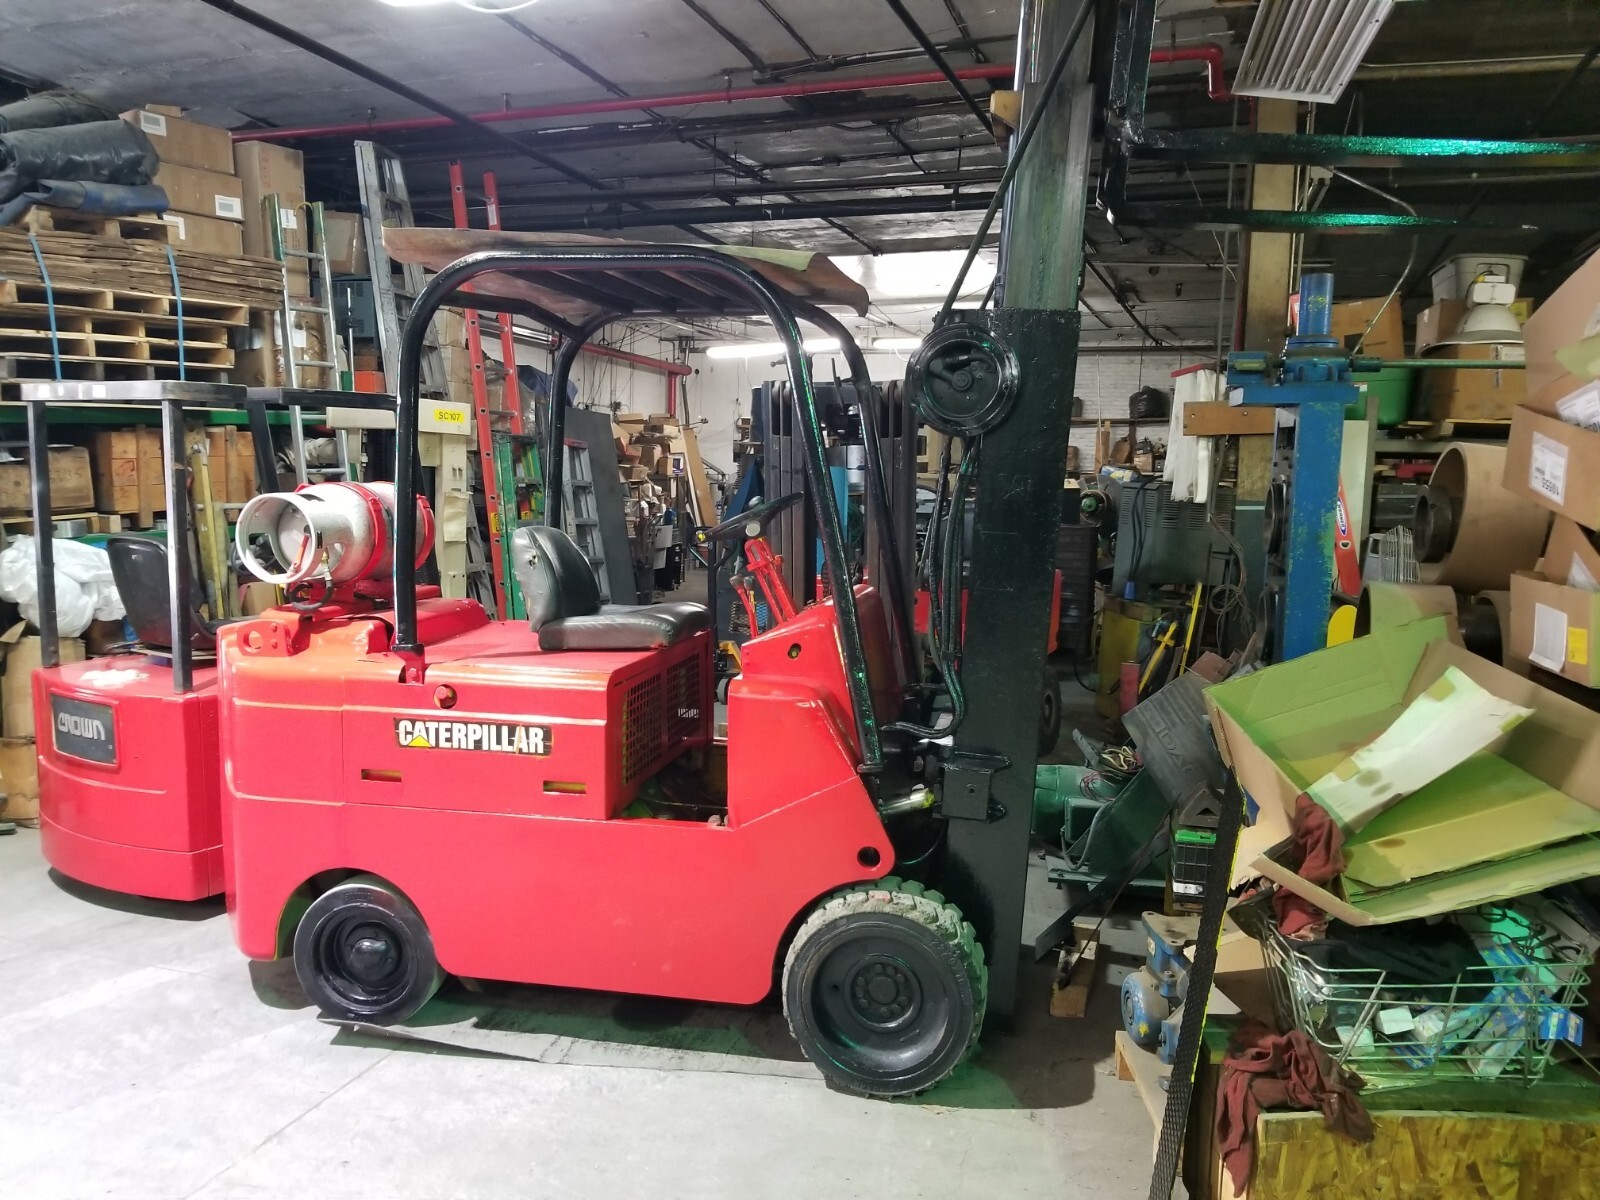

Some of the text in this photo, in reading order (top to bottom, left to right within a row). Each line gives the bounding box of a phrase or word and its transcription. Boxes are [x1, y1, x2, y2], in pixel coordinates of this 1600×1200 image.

[438, 411, 461, 421] SC107
[58, 712, 106, 741] CROWN
[399, 719, 545, 754] CATERPILLAR
